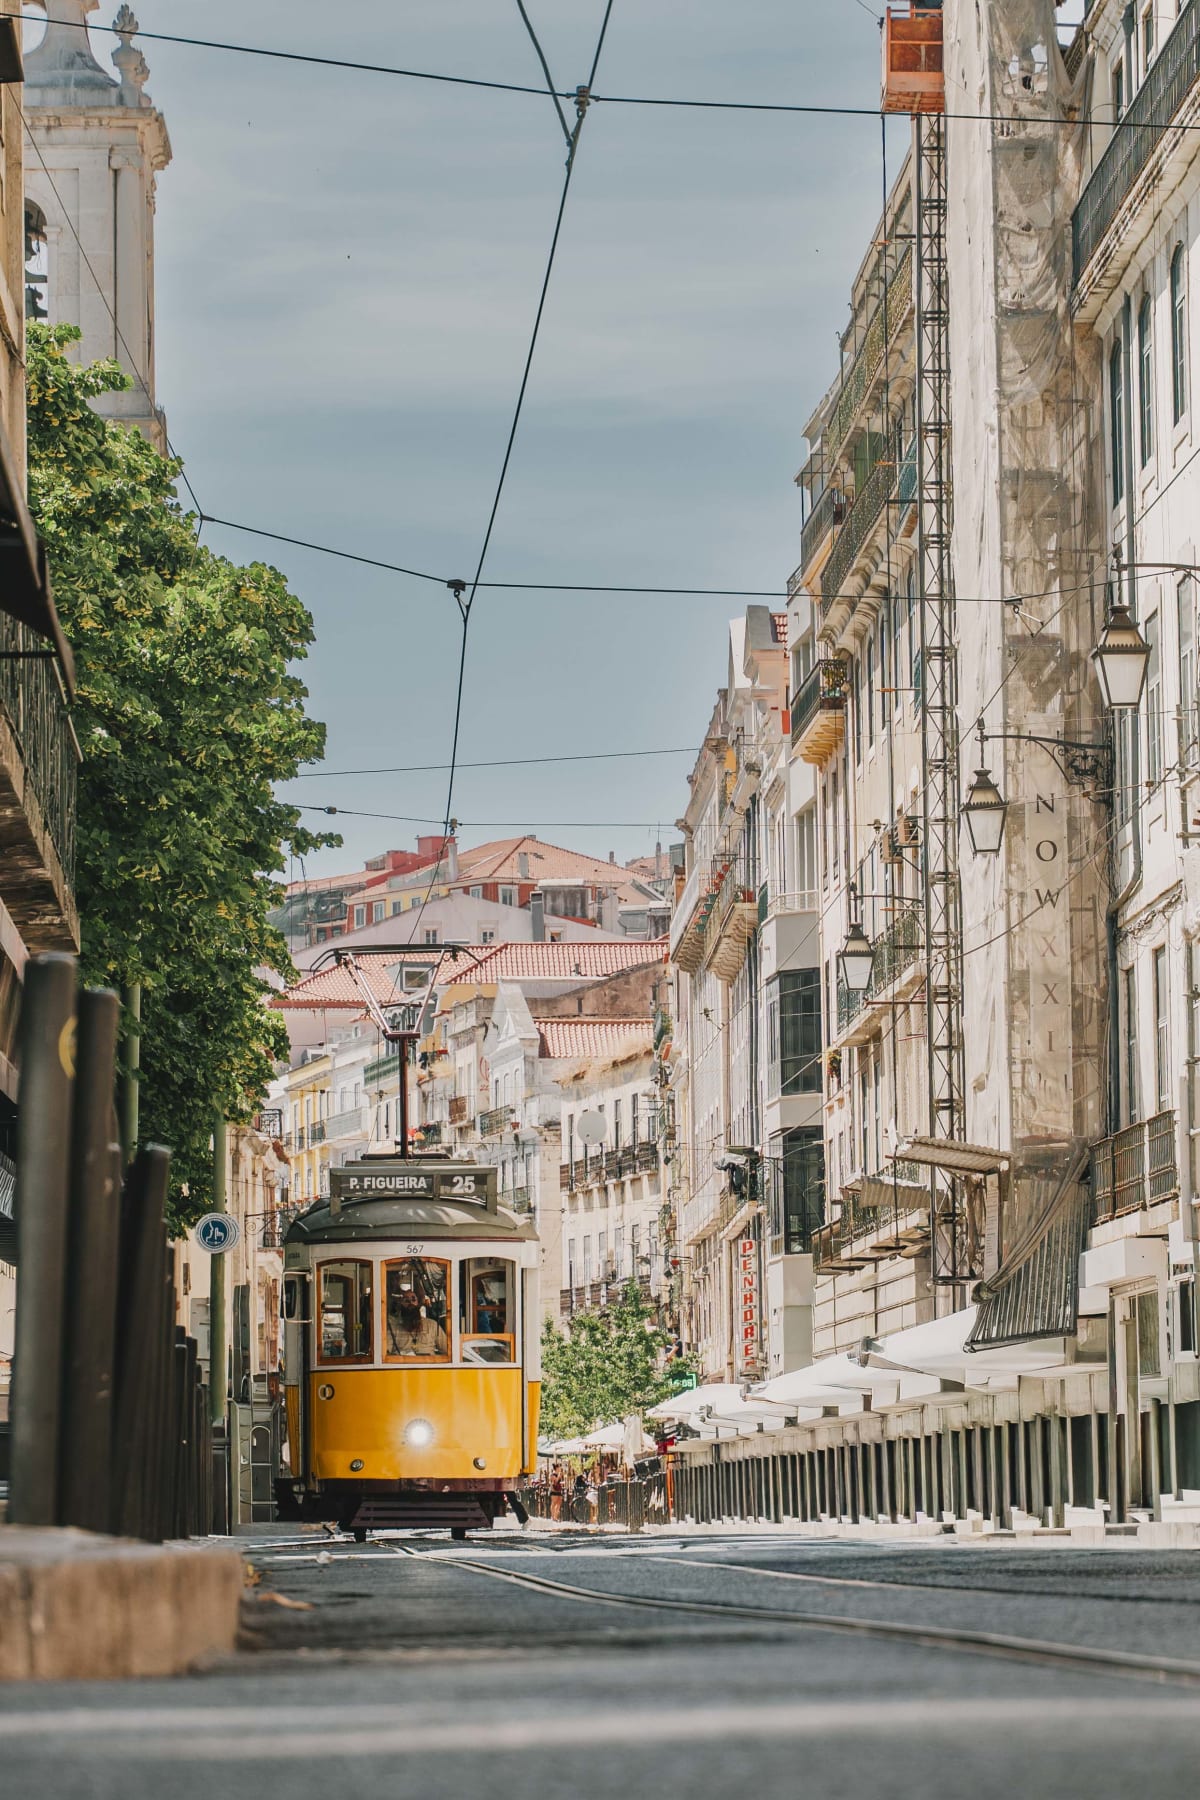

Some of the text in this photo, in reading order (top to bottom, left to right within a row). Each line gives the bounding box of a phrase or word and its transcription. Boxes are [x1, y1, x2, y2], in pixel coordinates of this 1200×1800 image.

[1035, 792, 1060, 910] NOW
[349, 1176, 428, 1190] P. FIGUEIRA
[452, 1175, 476, 1194] 25
[406, 1245, 424, 1254] 567
